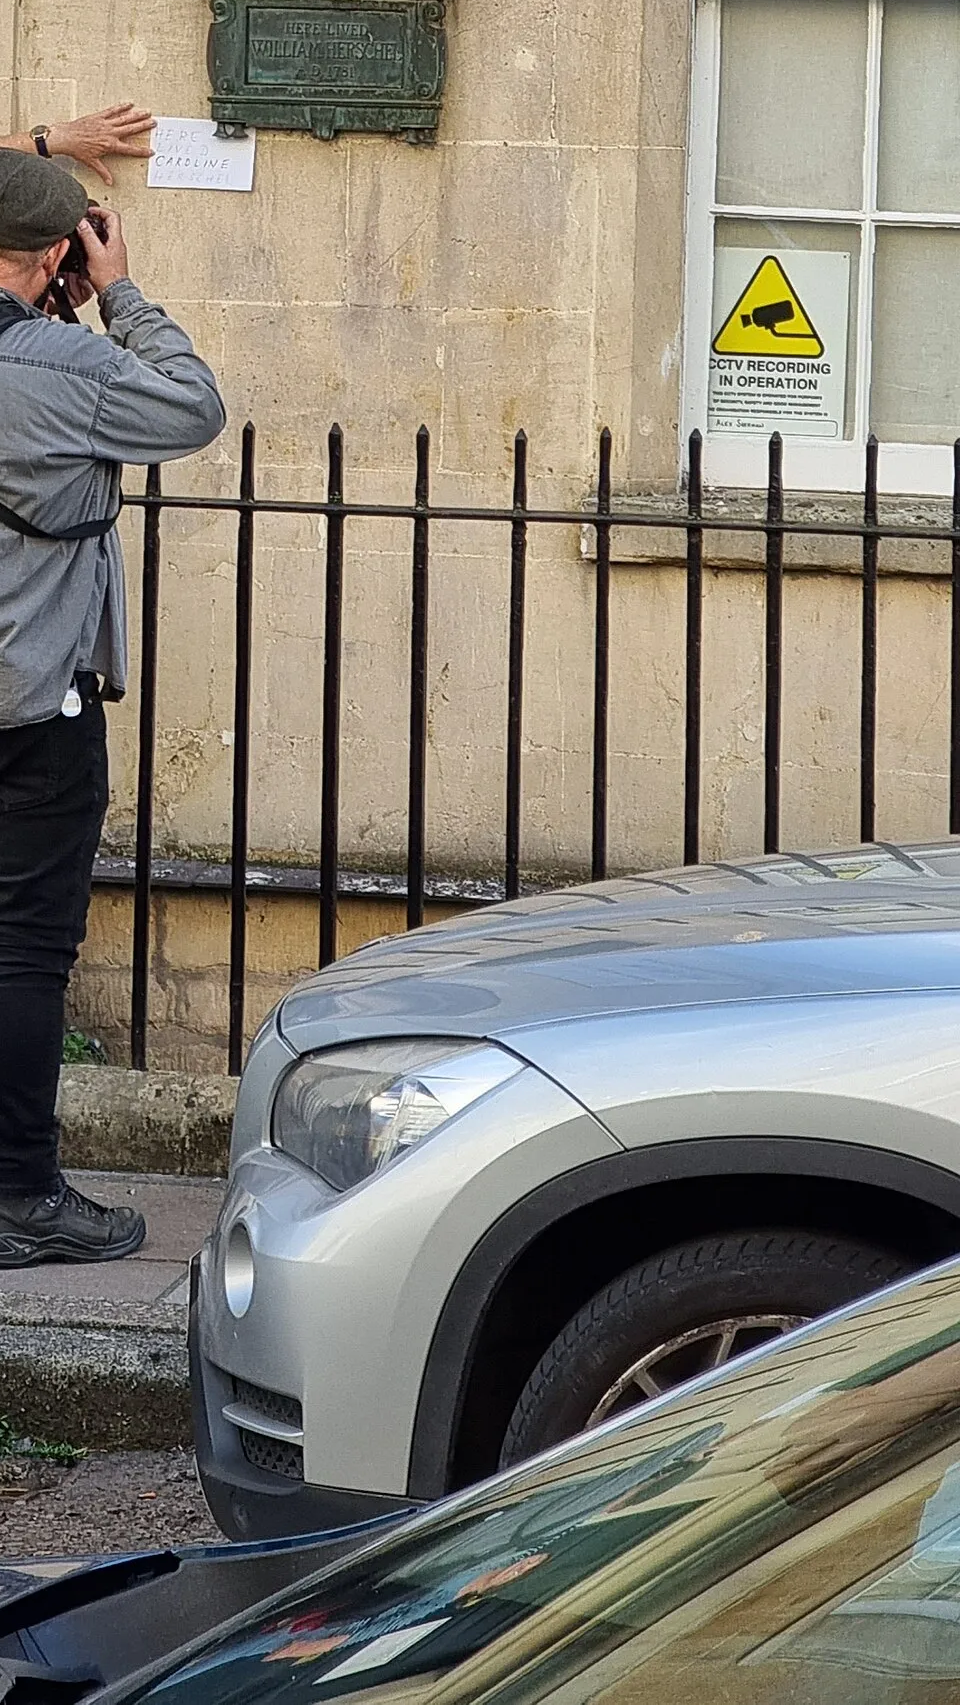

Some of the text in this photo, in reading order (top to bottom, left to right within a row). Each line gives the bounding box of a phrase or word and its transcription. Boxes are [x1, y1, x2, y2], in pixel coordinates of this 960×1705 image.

[284, 22, 369, 36] HERE LIVED
[251, 39, 404, 63] WILLIAM HERSCHEL
[327, 64, 356, 78] 1781
[155, 129, 202, 143] HERE
[156, 142, 209, 156] LIVED
[155, 155, 230, 170] CAROLINE
[709, 358, 832, 375] CCTV RECORDING
[719, 375, 818, 391] IN OPERATION
